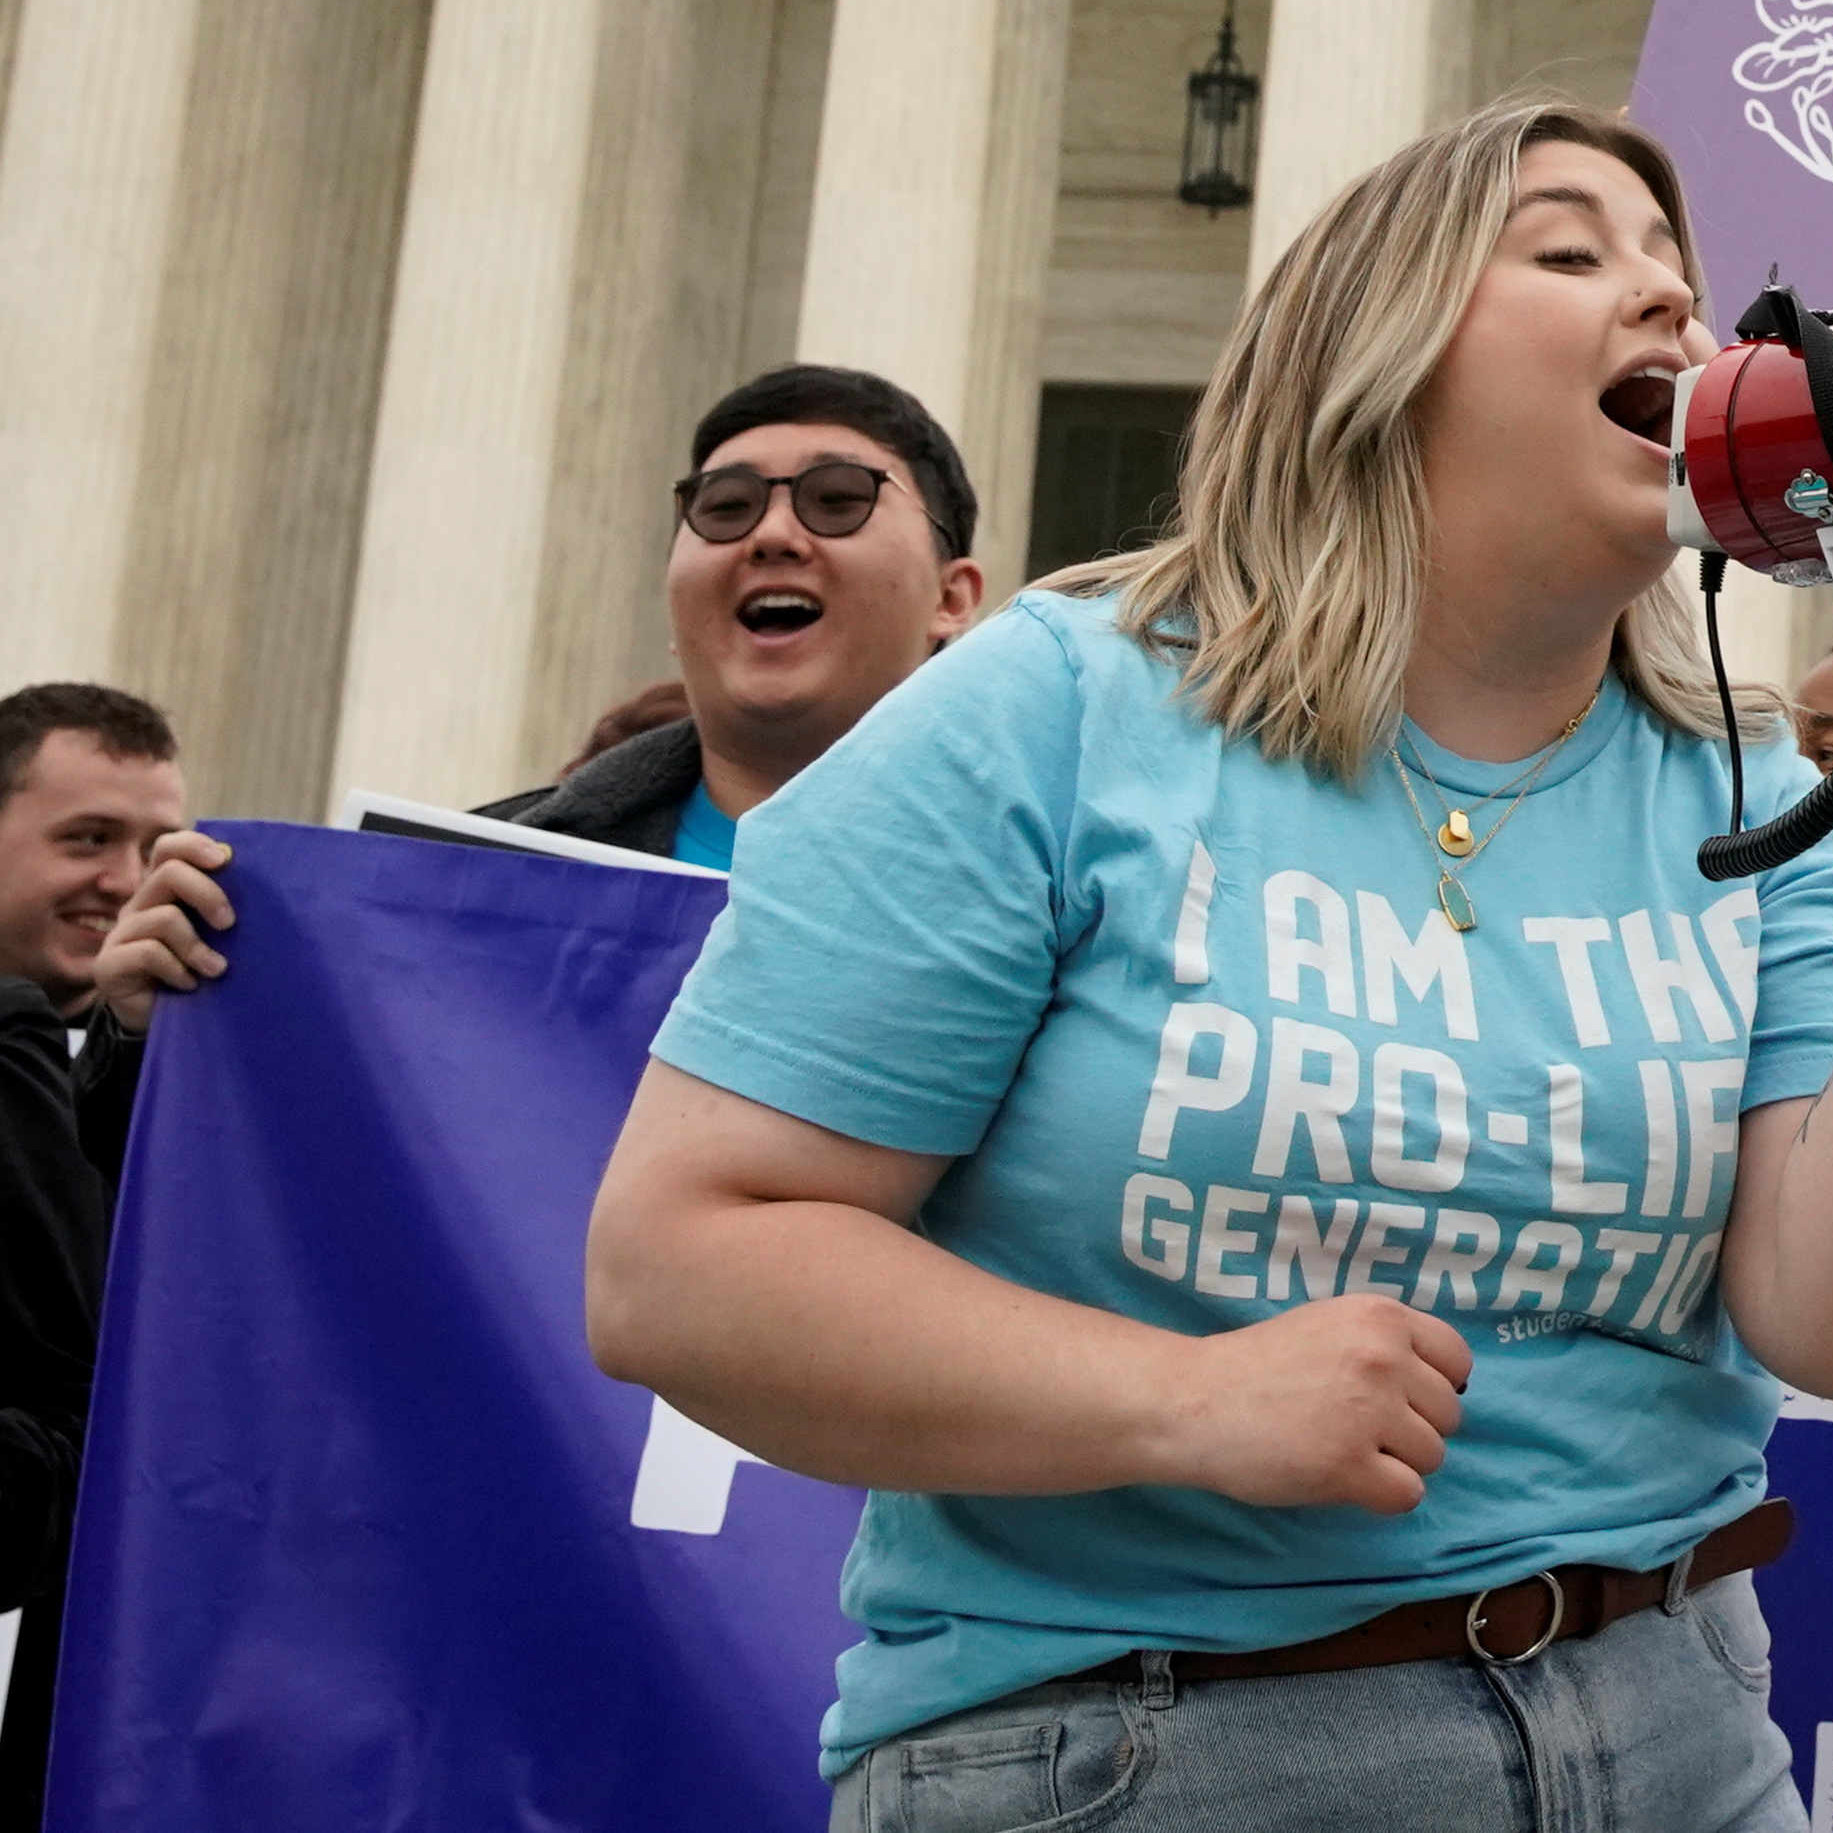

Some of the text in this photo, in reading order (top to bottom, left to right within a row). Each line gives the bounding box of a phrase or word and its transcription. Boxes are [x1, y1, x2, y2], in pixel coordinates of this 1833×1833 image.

[1174, 839, 1217, 985] I
[1263, 868, 1481, 1043] AM
[1137, 1002, 1747, 1221] PRO-LIF
[1121, 1173, 1724, 1338] GENERATIO
